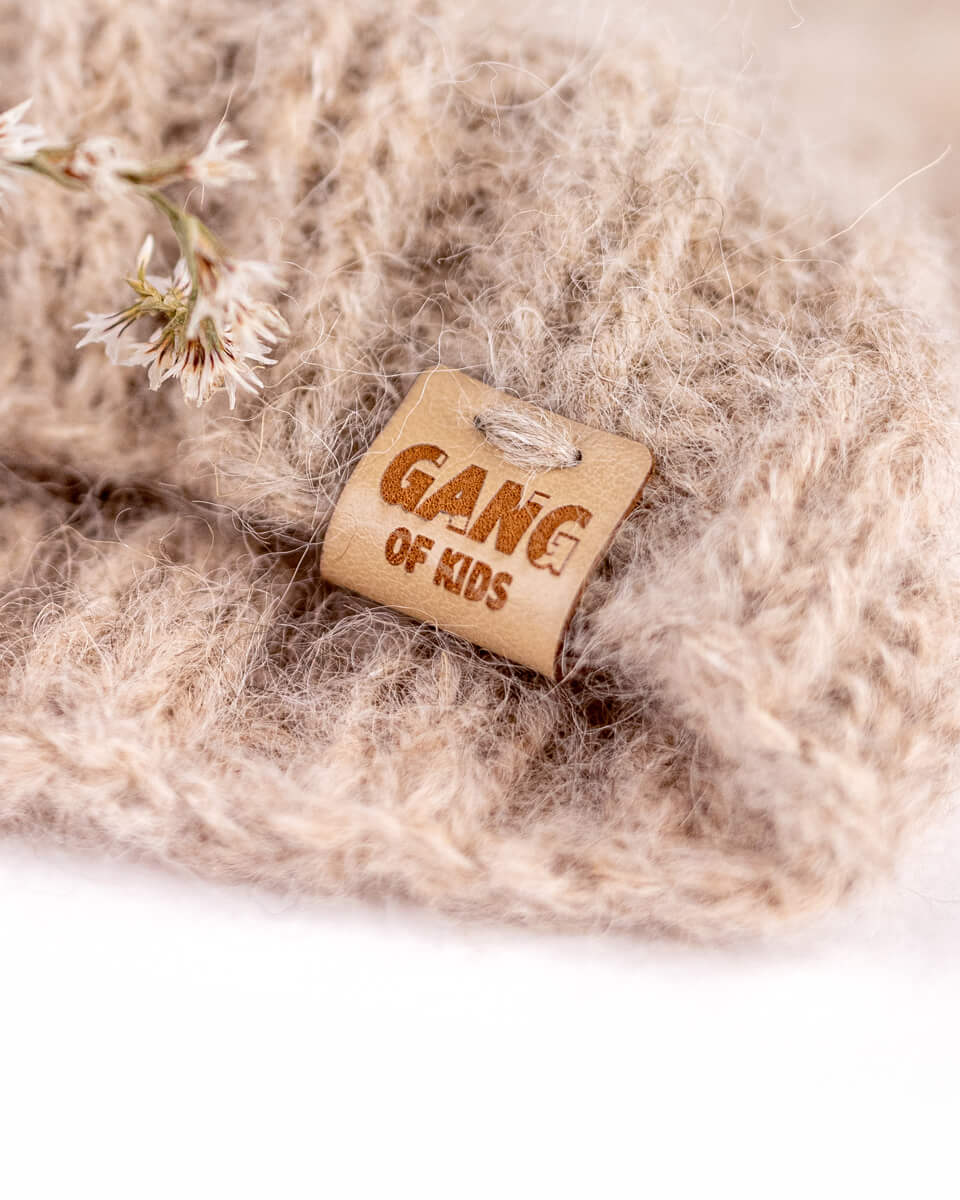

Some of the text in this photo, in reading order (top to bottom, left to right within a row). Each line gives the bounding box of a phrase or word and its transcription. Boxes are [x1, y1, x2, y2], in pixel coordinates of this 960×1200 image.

[379, 443, 593, 576] GANG
[384, 526, 513, 611] OF KIDS
